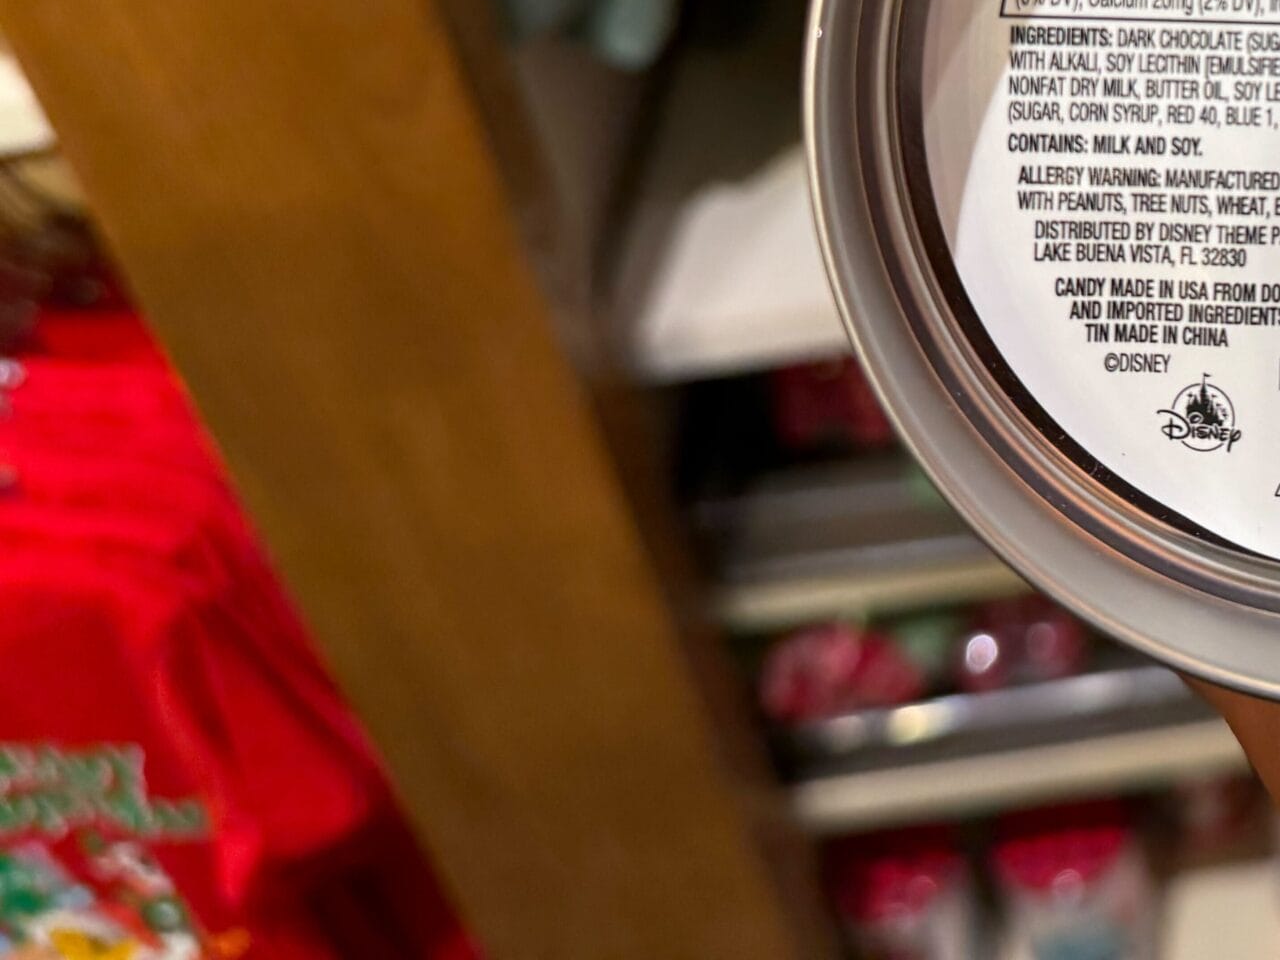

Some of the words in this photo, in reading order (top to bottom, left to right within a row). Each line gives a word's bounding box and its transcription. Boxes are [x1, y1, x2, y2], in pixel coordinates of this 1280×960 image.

[1009, 25, 1112, 50] INGREDIENTS:
[1117, 28, 1155, 49] DARK
[1008, 50, 1045, 71] WITH
[1009, 76, 1066, 97] NONFAT
[1068, 102, 1109, 123] CORN
[1008, 133, 1088, 154] CONTAINS:
[1093, 135, 1130, 155] MILK
[1134, 136, 1167, 156] AND
[1018, 165, 1084, 186] ALLERGY
[1088, 166, 1161, 188] WARNING:
[1165, 168, 1280, 192] MANUFACTURED
[1017, 190, 1054, 211] WITH
[1058, 191, 1127, 215] PEANUTS,
[1035, 220, 1131, 241] DISTRIBUTED
[1159, 222, 1212, 244] DISNEY
[1216, 224, 1267, 245] THEME
[1034, 244, 1071, 263] LAKE
[1076, 245, 1126, 263] BUENA
[1130, 246, 1175, 267] VISTA,
[1201, 247, 1247, 268] 32830
[1055, 277, 1106, 298] CANDY
[1110, 278, 1154, 299] MADE
[1179, 280, 1209, 301] USA
[1213, 282, 1256, 303] FROM
[1070, 300, 1102, 320] AND
[1107, 301, 1184, 323] IMPORTED
[1085, 324, 1109, 343] TIN
[1114, 325, 1158, 344] MADE
[1182, 326, 1228, 347] CHINA
